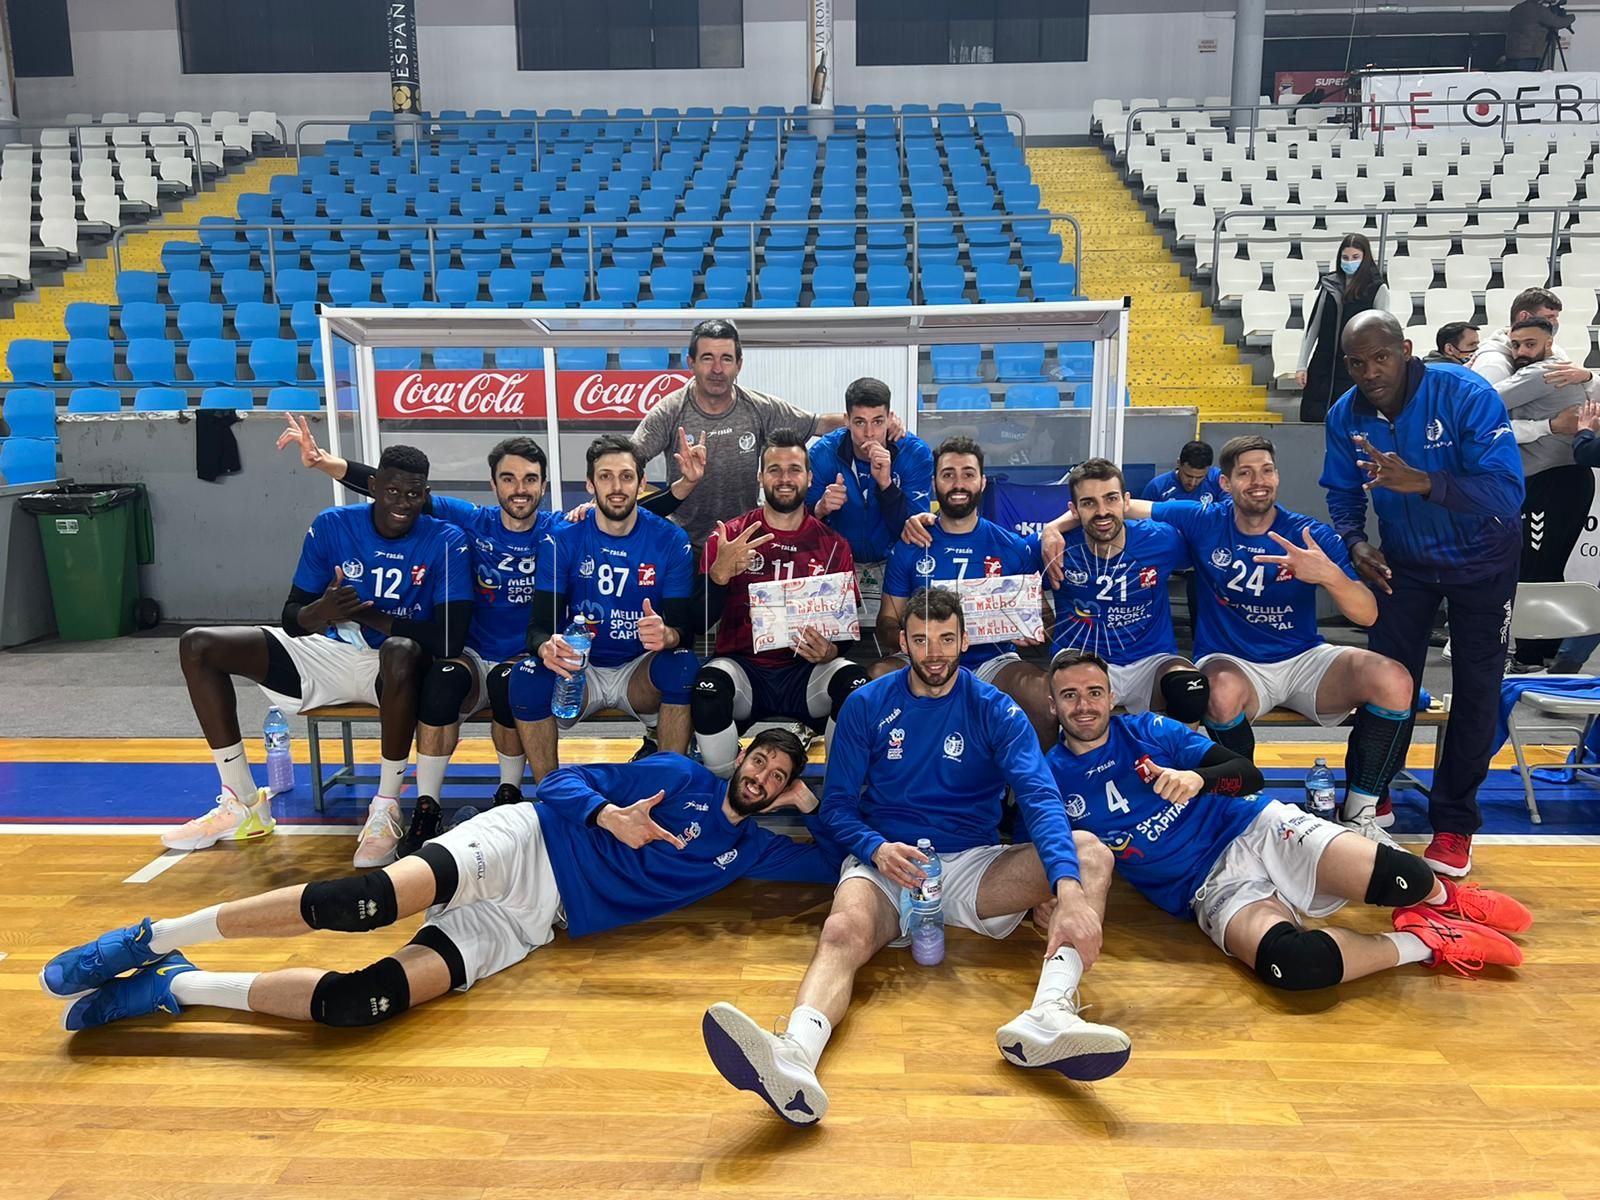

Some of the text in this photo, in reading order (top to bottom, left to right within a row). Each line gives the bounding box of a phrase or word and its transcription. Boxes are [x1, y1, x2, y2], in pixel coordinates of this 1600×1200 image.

[393, 373, 529, 414] Coca-Cola
[573, 373, 695, 415] Coca-C
[497, 552, 536, 574] 28
[771, 559, 795, 581] 11
[952, 557, 969, 580] 7
[1227, 559, 1265, 597] 24
[371, 567, 403, 600] 12
[507, 576, 535, 586] MELI
[507, 586, 535, 595] SPO
[597, 563, 630, 597] 87
[1095, 575, 1127, 602] 21
[1106, 779, 1131, 815] 4
[1147, 800, 1190, 842] CAPITAL
